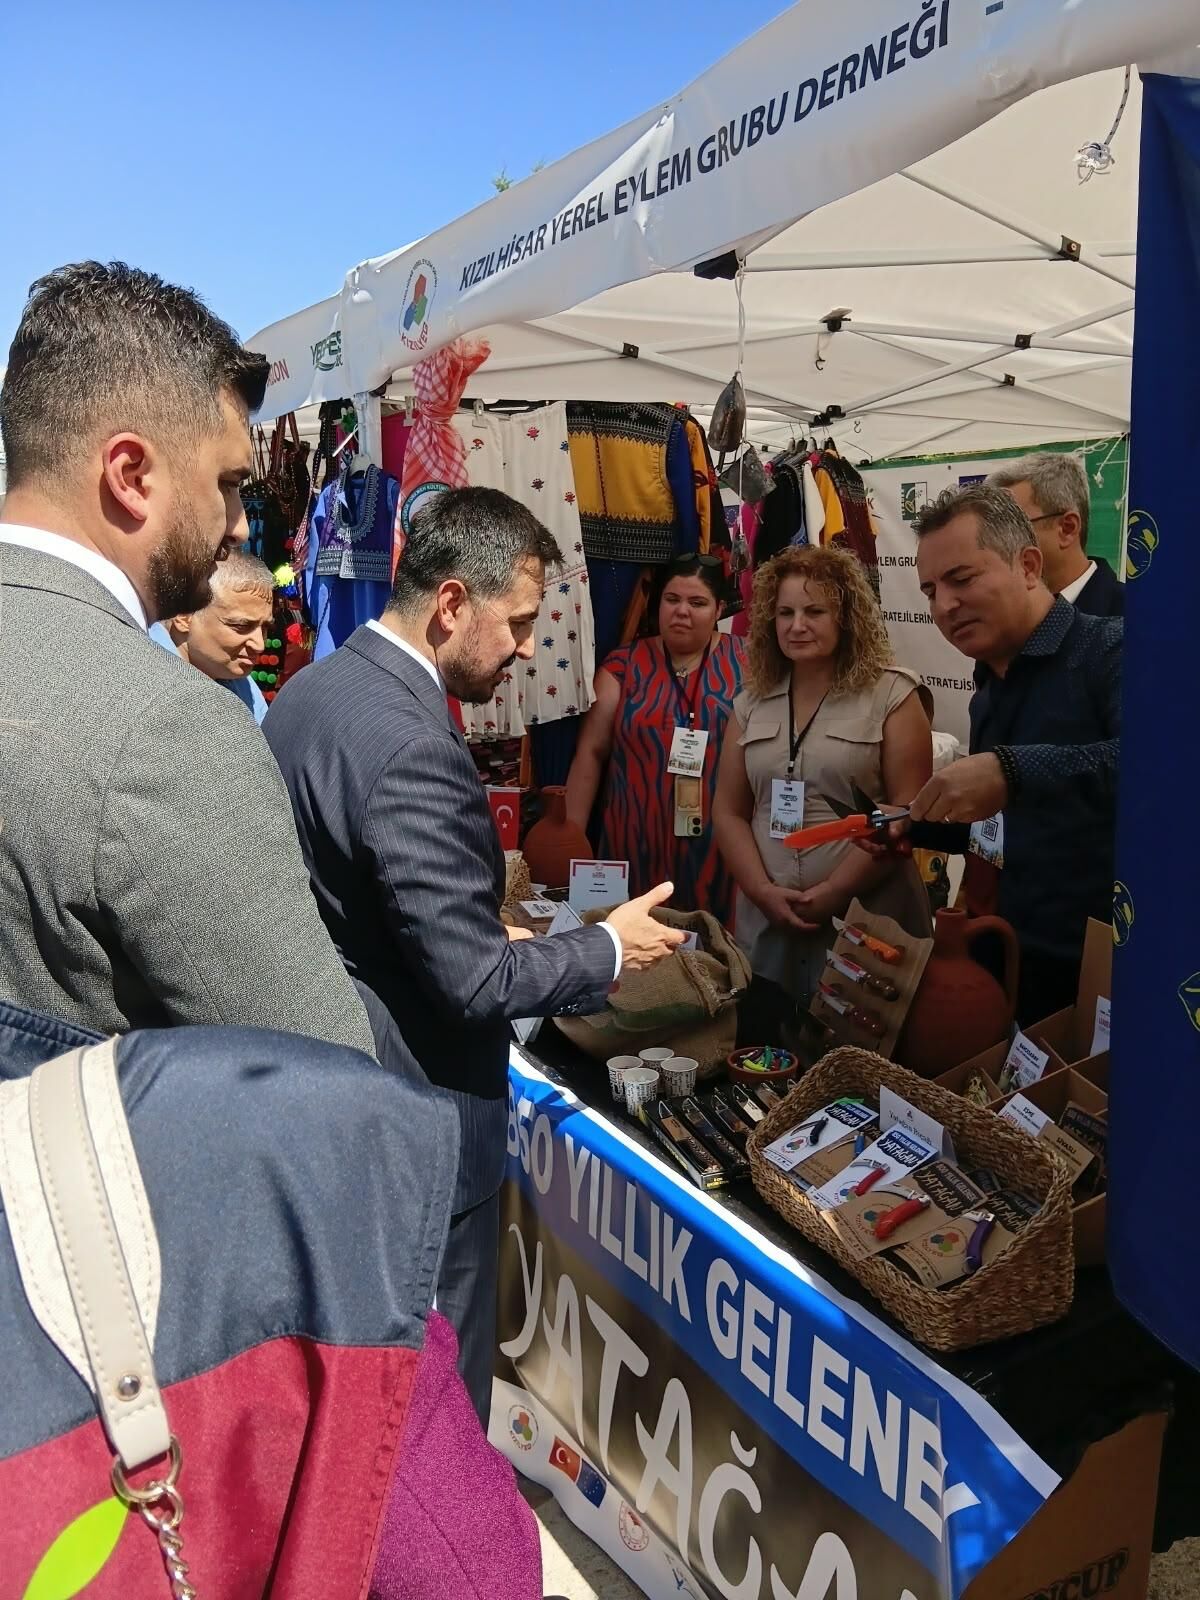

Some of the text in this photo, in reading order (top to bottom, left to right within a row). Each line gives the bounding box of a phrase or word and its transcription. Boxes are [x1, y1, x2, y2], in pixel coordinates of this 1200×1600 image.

[459, 222, 548, 292] KIZILHİSAR
[551, 191, 609, 245] YEREL
[614, 146, 691, 216] EYLEM
[697, 91, 789, 173] GRUBU
[507, 1081, 981, 1544] 850 YILLIK GELENE
